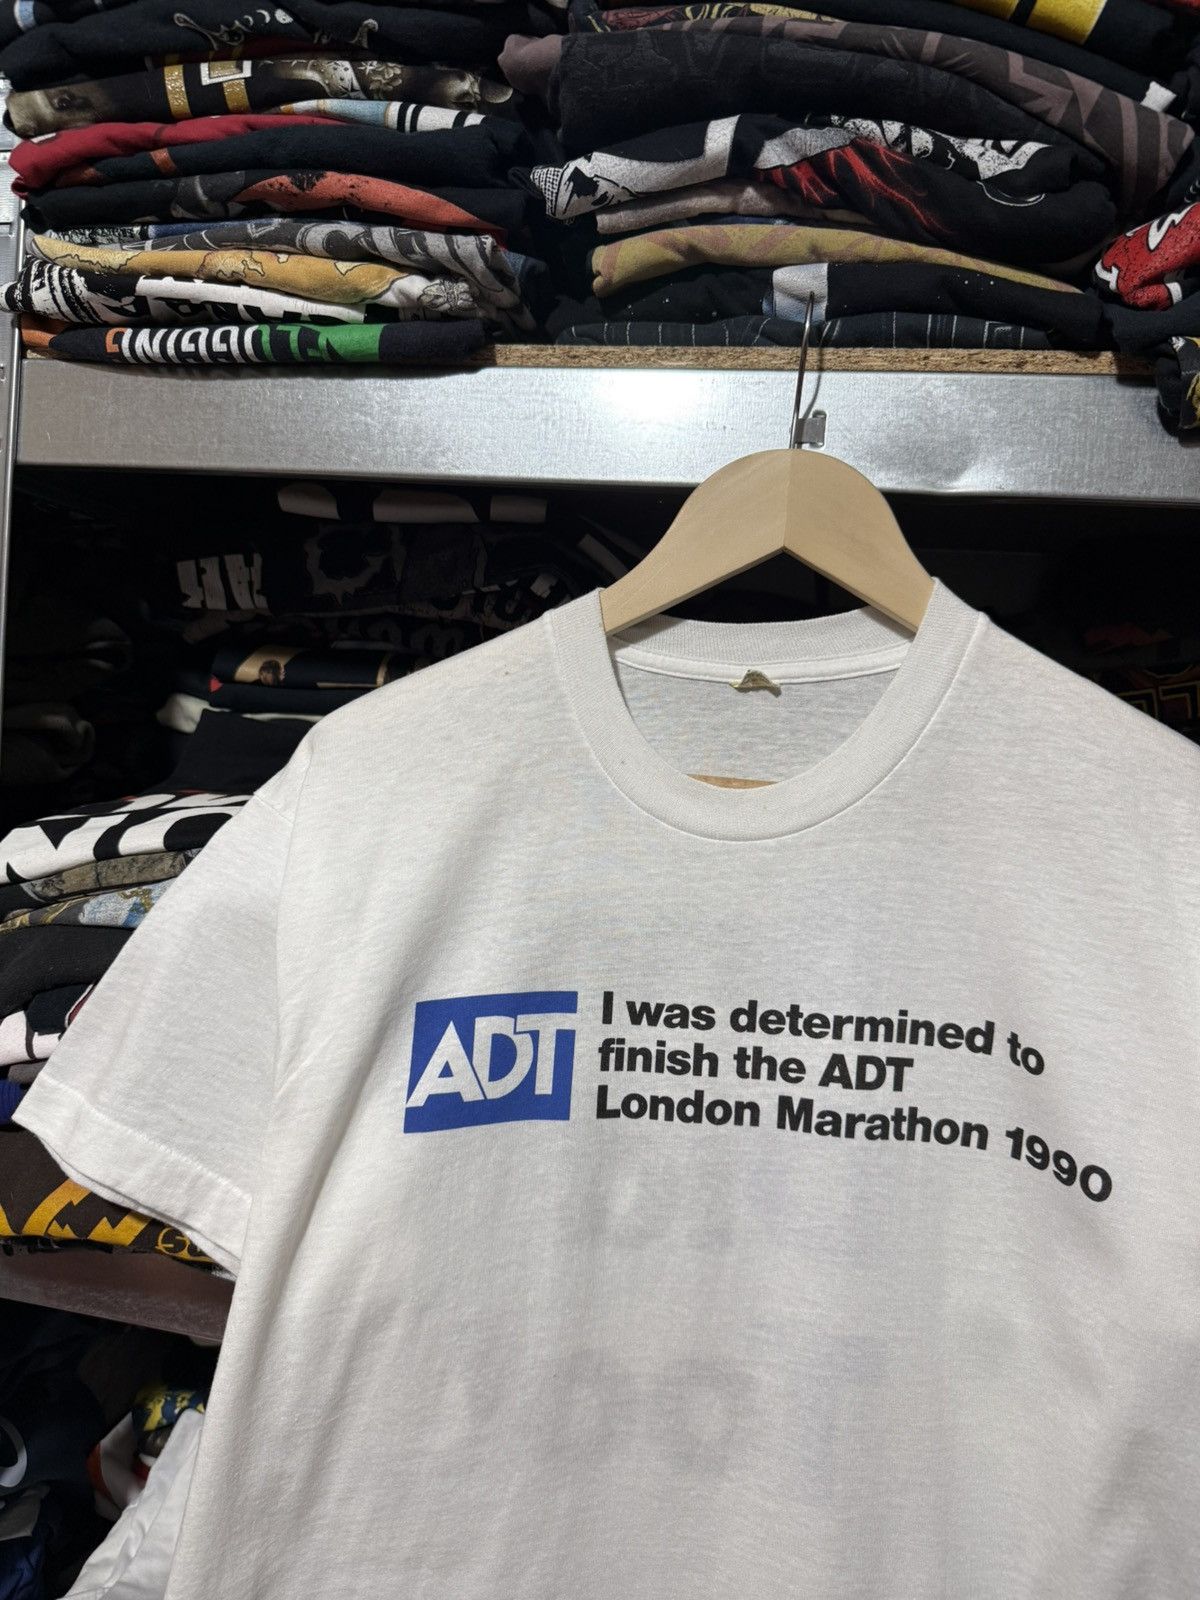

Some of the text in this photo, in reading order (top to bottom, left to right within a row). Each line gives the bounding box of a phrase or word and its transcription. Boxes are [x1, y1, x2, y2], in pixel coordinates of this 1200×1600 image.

[405, 1012, 578, 1108] ADT
[598, 1038, 914, 1092] finish the ADT
[602, 990, 1045, 1076] I was determined to
[596, 1084, 1113, 1203] London Marathon 1990
